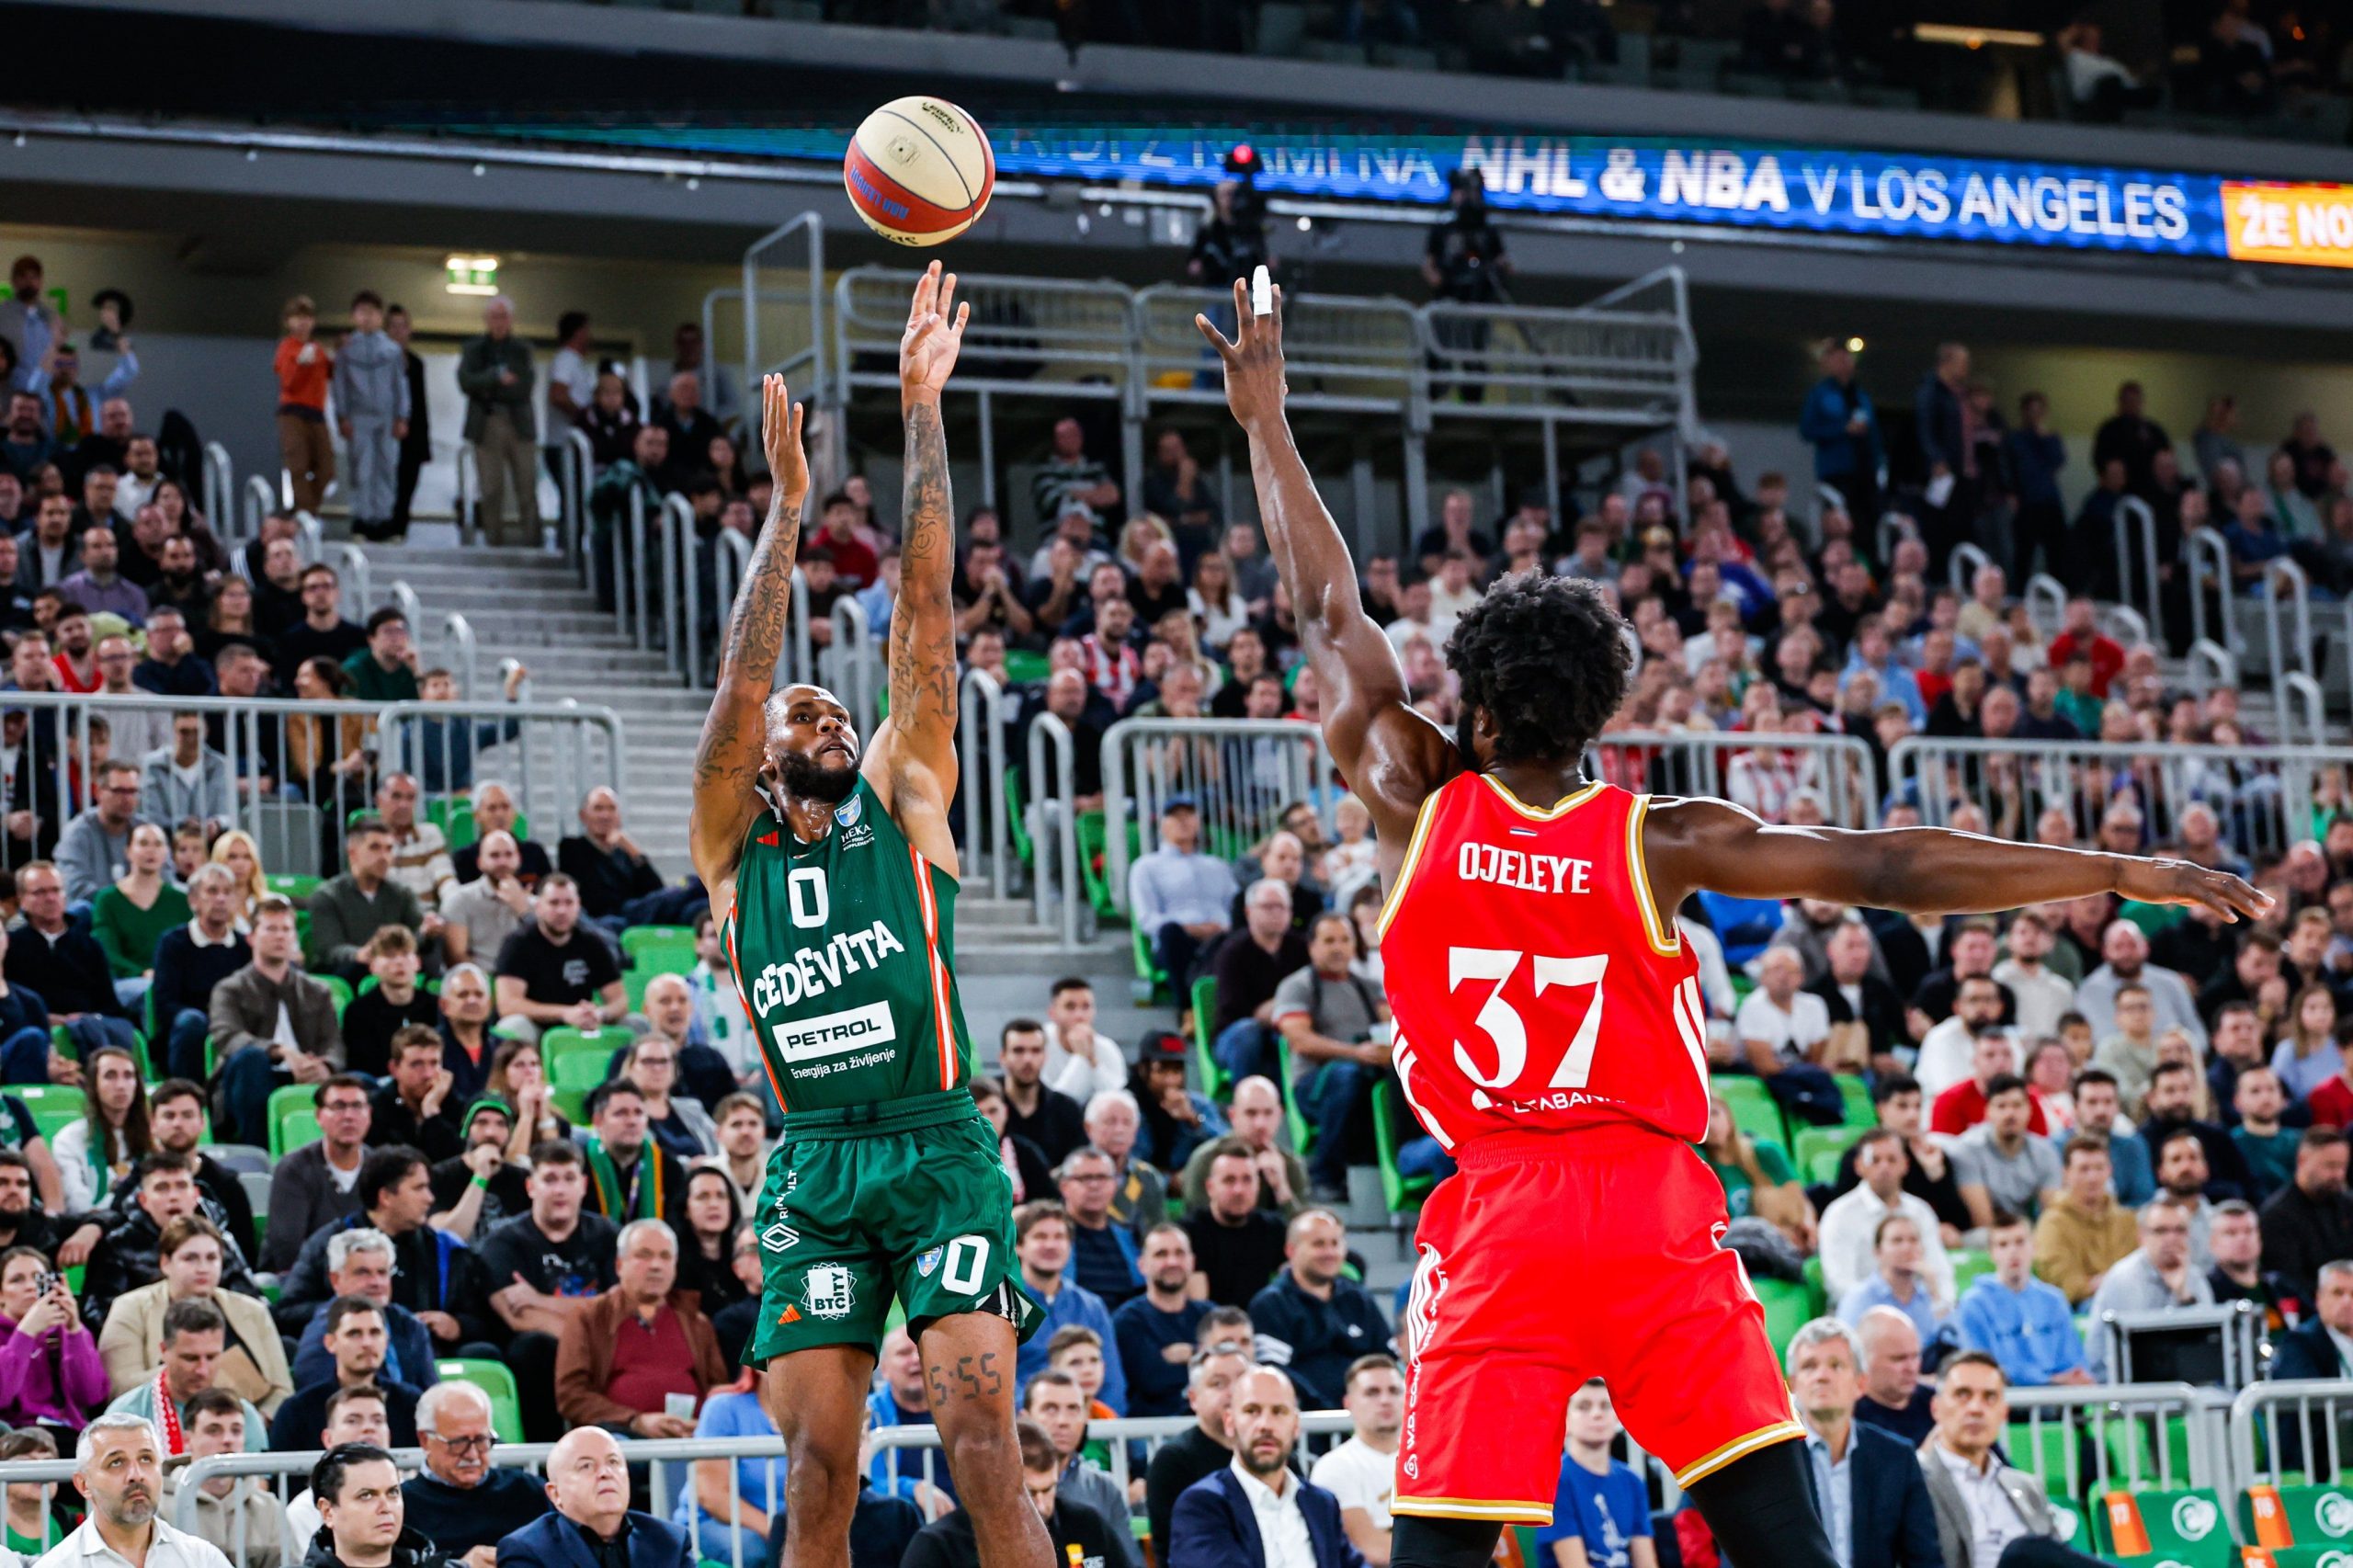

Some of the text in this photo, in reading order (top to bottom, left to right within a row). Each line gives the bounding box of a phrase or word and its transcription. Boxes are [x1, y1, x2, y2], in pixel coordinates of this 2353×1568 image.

[1461, 136, 1588, 199] NHL
[1599, 147, 1647, 202] &
[1657, 148, 1790, 213] NBA
[1801, 165, 1839, 217] V
[1850, 165, 1952, 224] LOS
[1958, 171, 2190, 241] ANGELES
[2238, 193, 2353, 249] ŽE NO
[840, 824, 872, 843] HEKA
[1458, 841, 1593, 895] OJELEYE
[788, 866, 830, 929] 0
[752, 920, 905, 1018] CEDEVITA
[786, 1018, 882, 1049] PETROL
[1448, 946, 1609, 1089] 37
[790, 1048, 896, 1079] Energija za življenje
[940, 1233, 991, 1297] 0
[814, 1296, 847, 1311] BTC
[1405, 1411, 1416, 1450] W.D.
